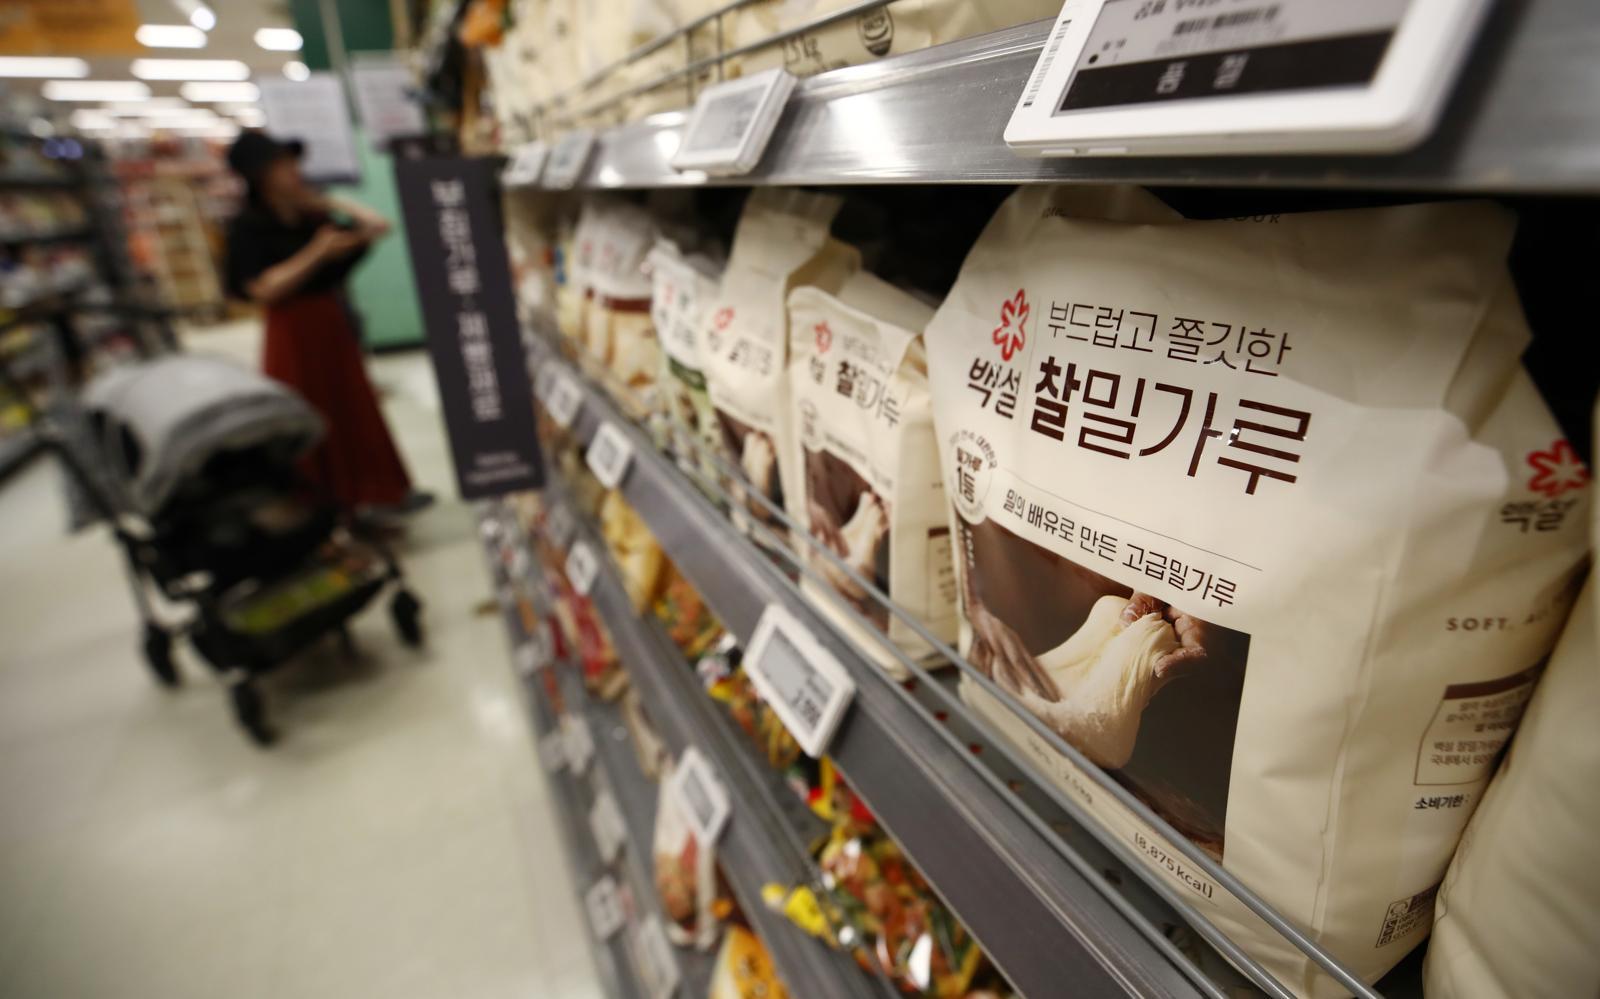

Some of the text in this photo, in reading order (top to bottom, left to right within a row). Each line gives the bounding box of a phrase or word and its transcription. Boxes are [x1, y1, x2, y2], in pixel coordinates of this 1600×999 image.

[1048, 301, 1292, 377] 부드럽고 쫄깃한
[967, 357, 1022, 420] 백설
[1031, 356, 1312, 496] 찰밀가루
[957, 466, 976, 504] 1등
[1003, 489, 1026, 520] 밀의
[1027, 503, 1075, 543] 배유로
[1080, 526, 1118, 562] 만든
[1122, 543, 1237, 608] 고급밀가루
